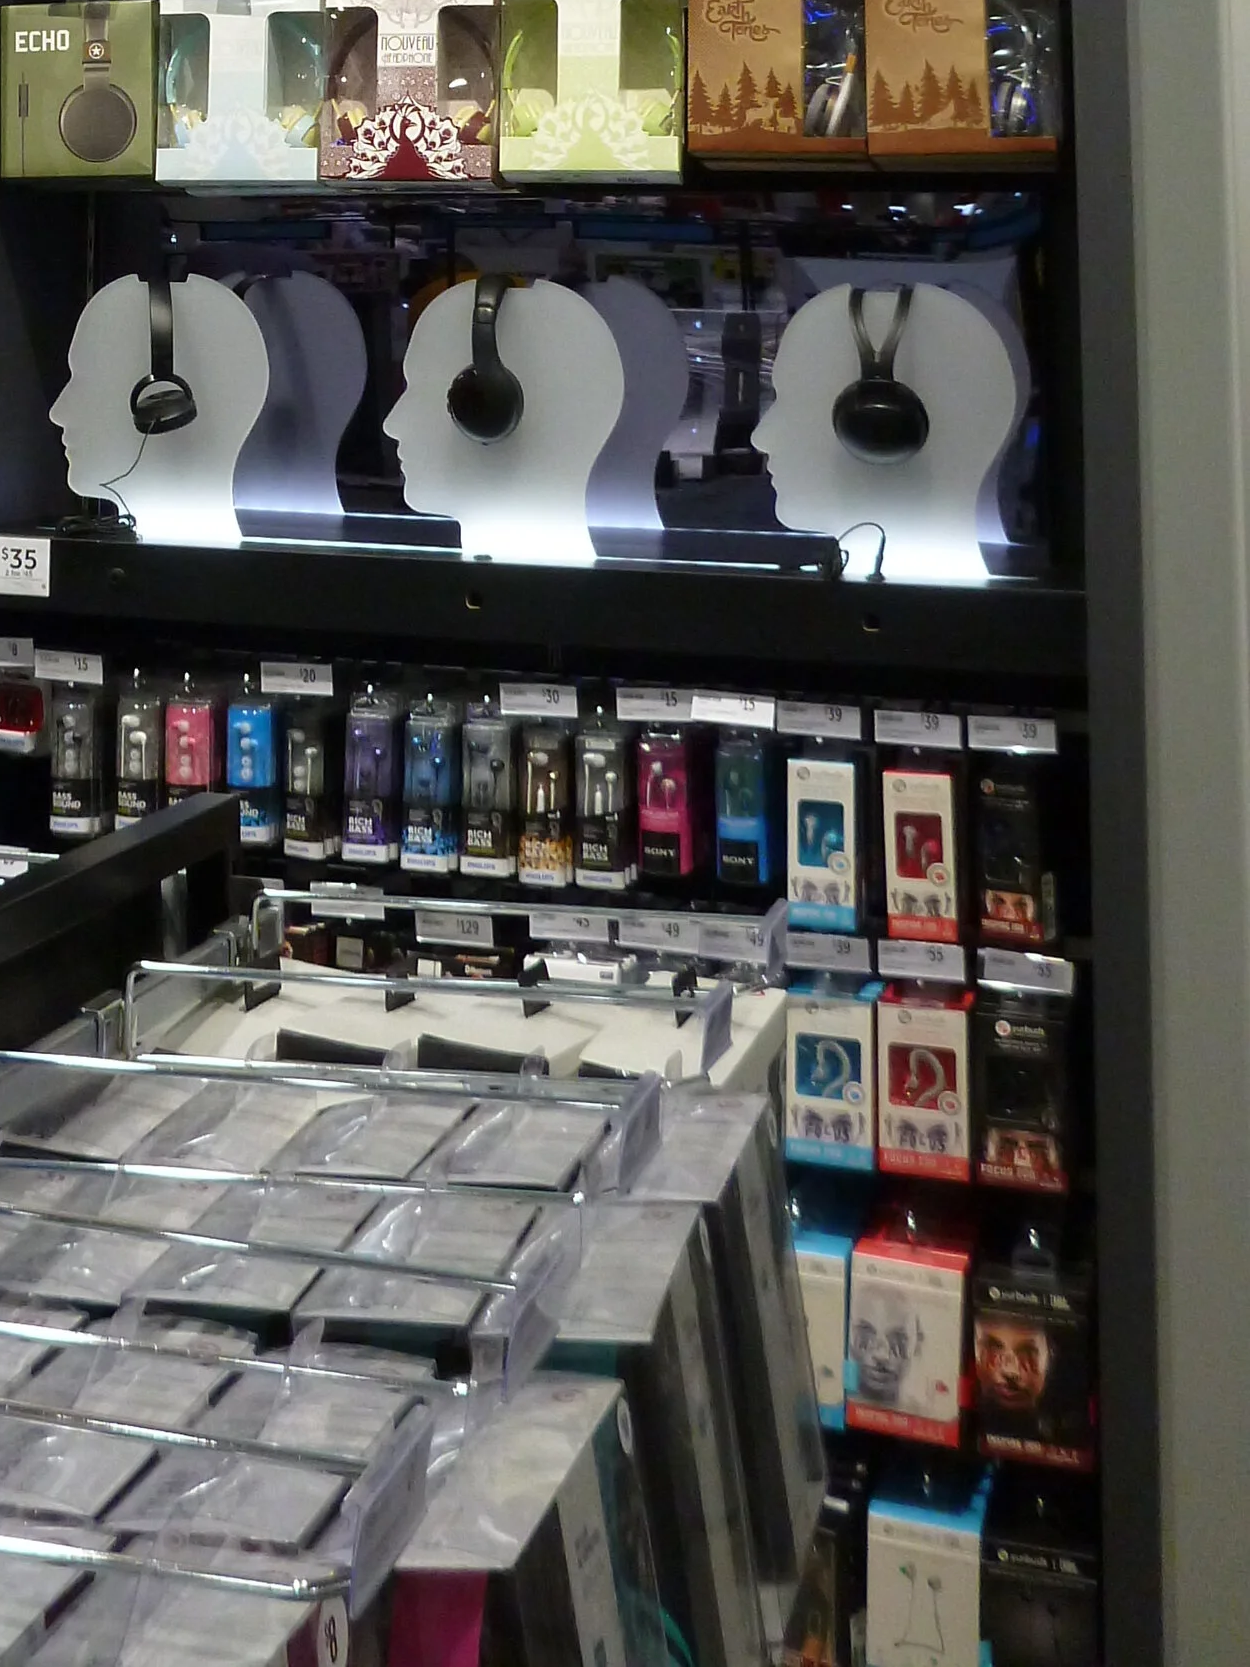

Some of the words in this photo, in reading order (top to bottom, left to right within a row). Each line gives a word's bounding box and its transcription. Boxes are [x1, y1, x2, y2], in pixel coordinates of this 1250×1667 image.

[900, 12, 964, 34] Tones
[719, 20, 782, 42] Tones
[15, 29, 70, 53] ECHO
[380, 34, 435, 52] NOUVEAU
[1, 546, 37, 571] $35
[73, 655, 88, 672] $15
[660, 690, 678, 708] $15
[348, 817, 373, 826] RICH
[348, 824, 373, 834] BASS
[408, 825, 432, 834] RICH
[467, 829, 492, 839] RICH
[408, 833, 433, 843] BASS
[467, 837, 493, 848] BASS
[582, 842, 608, 853] RICH
[644, 845, 676, 858] SONY
[722, 854, 755, 866] SONY
